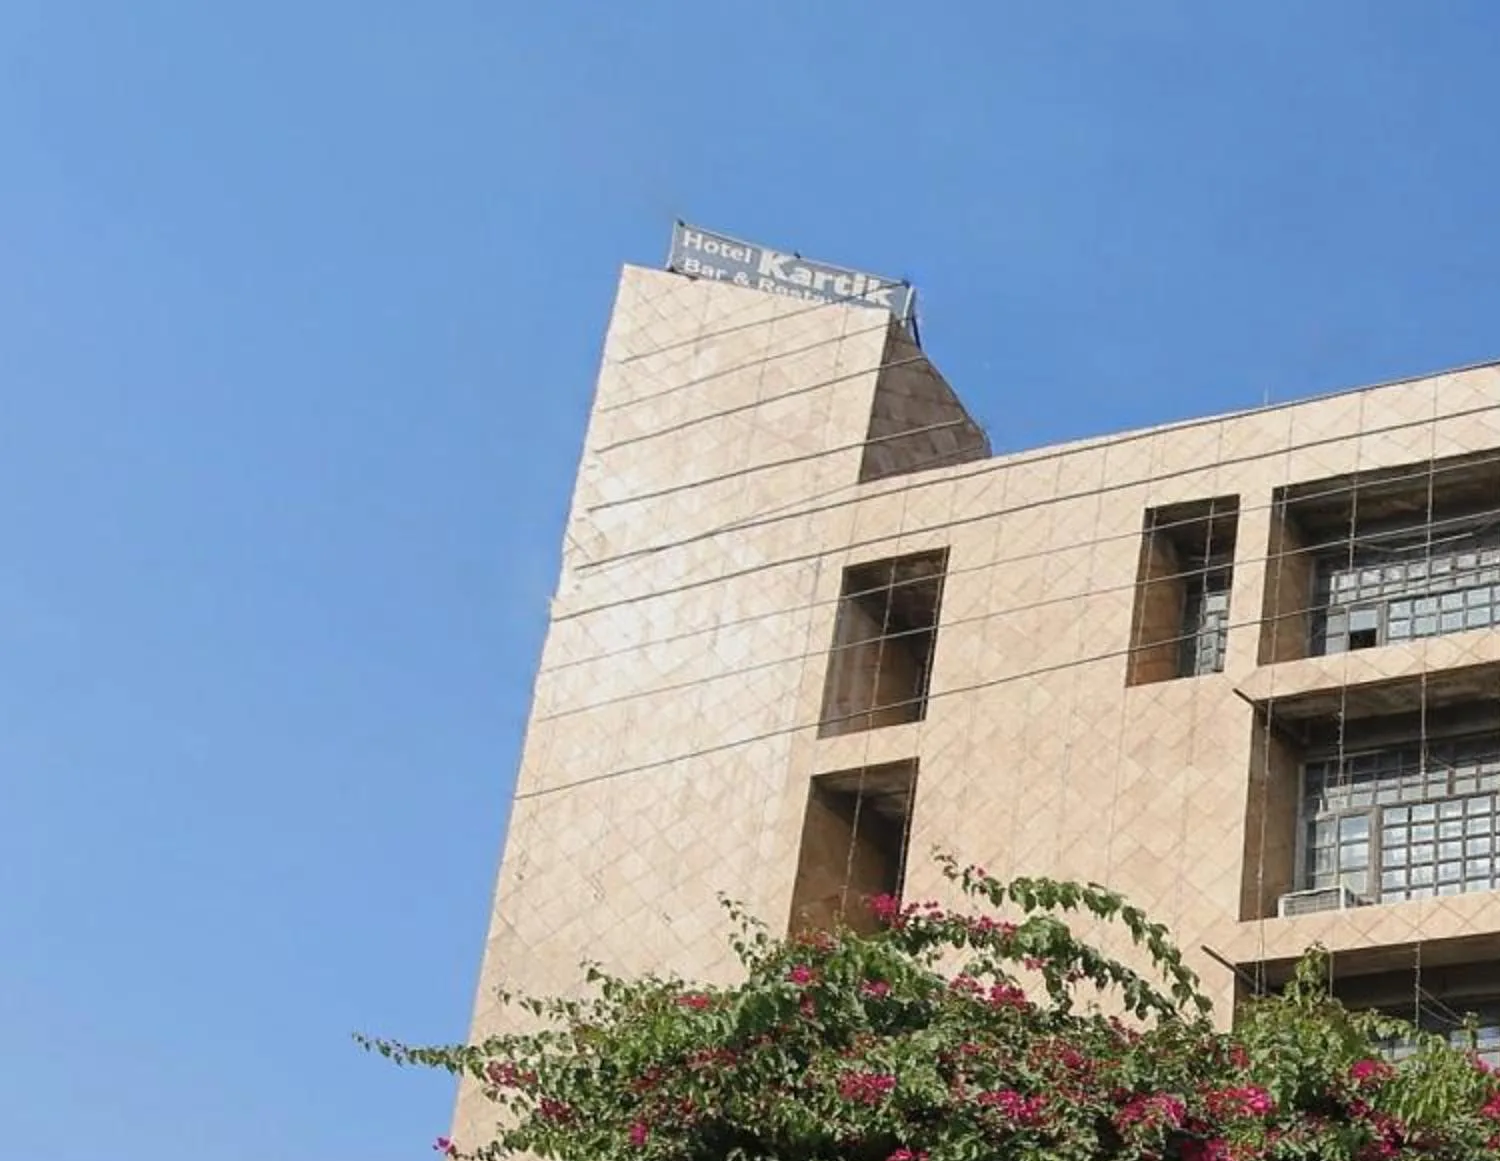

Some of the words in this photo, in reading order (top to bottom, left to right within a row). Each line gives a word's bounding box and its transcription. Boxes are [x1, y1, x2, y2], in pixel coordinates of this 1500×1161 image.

[683, 230, 752, 264] Hotel
[757, 249, 893, 307] Kartik
[684, 257, 729, 280] Bar
[733, 271, 750, 287] &
